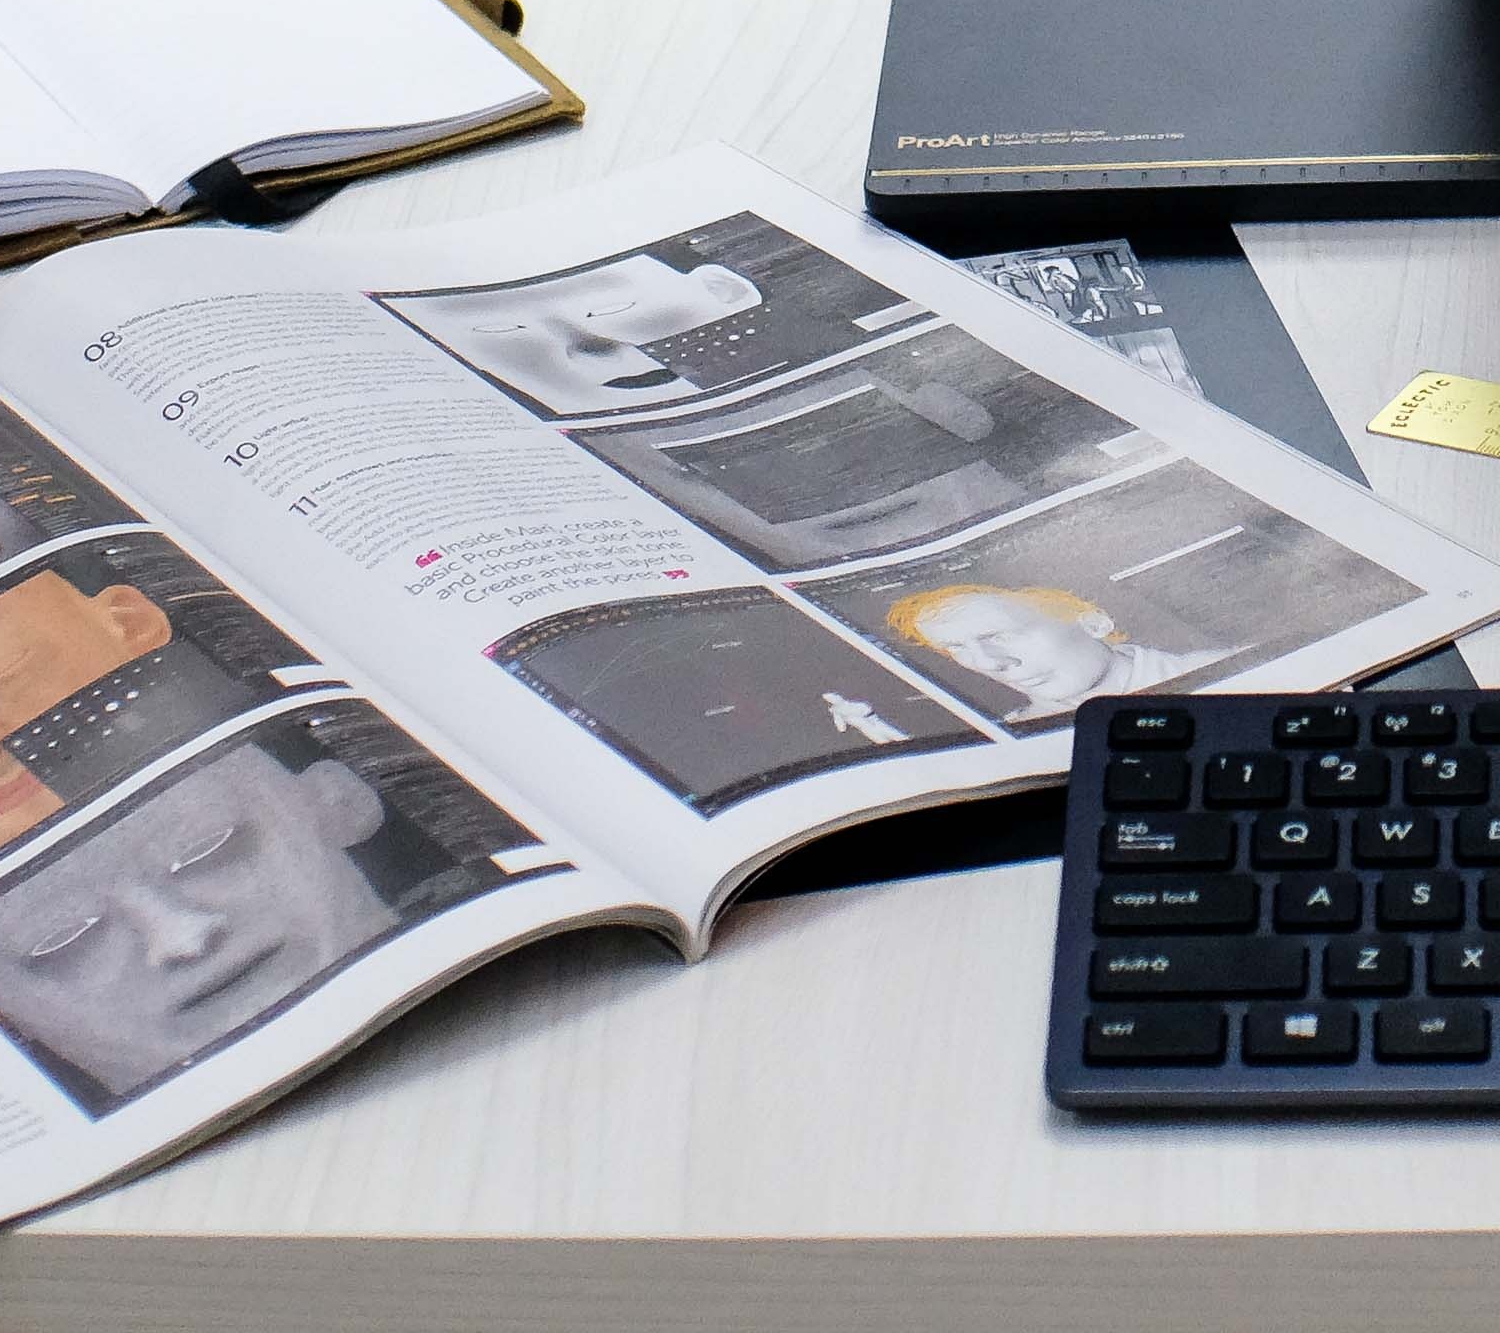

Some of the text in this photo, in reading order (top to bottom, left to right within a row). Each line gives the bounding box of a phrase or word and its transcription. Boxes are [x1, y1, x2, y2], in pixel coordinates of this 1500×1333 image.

[898, 133, 991, 149] ProArt
[84, 331, 123, 363] 08
[162, 389, 199, 421] 09
[1391, 379, 1451, 428] ECLECTIC
[224, 442, 259, 468] 10
[289, 496, 318, 516] 11
[404, 528, 681, 596] basic Procedural Color layer
[436, 573, 476, 601] and
[480, 552, 553, 578] choose
[556, 547, 591, 559] the
[594, 543, 635, 556] skin
[463, 553, 694, 603] Create another layer to
[508, 583, 564, 607] paint
[567, 575, 599, 590] the
[1137, 718, 1166, 727] esc
[1244, 765, 1252, 782] 1
[1334, 759, 1356, 780] 2
[1434, 756, 1457, 779] 3
[1280, 823, 1308, 843] Q
[1381, 823, 1413, 840] W
[1113, 894, 1156, 906] caps
[1163, 891, 1199, 903] lock
[1307, 887, 1330, 905] A
[1412, 884, 1430, 904] S
[1357, 948, 1378, 969] Z
[1462, 949, 1483, 967] X
